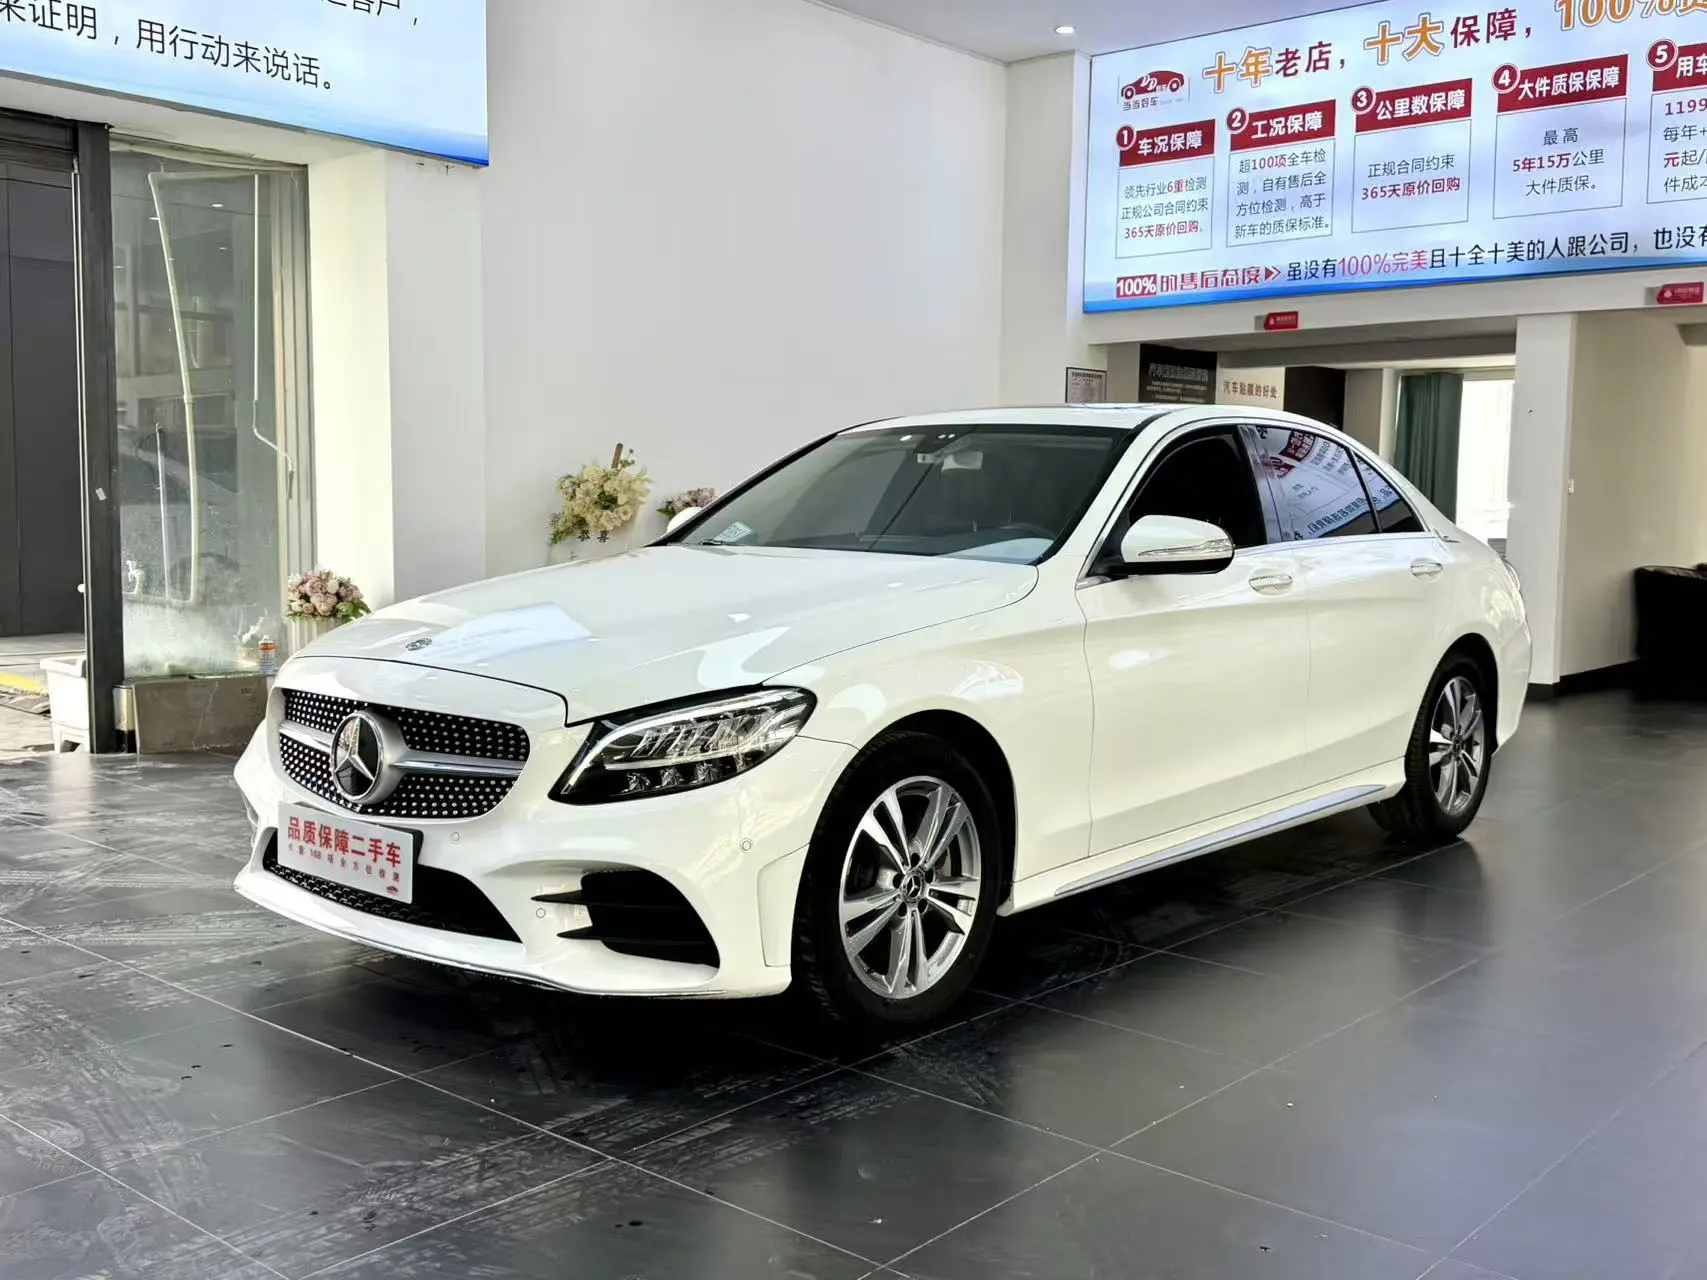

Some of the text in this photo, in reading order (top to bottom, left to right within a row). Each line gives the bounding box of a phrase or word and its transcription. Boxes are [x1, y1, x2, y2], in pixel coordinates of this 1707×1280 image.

[0, 0, 332, 90] 来证明，用行动来说话。
[1518, 66, 1620, 101] 大件质保保障
[1376, 89, 1466, 120] 公里数保障
[1252, 111, 1323, 139] 工况保障
[1543, 127, 1579, 146] 最高
[1137, 130, 1203, 156] 车况保障
[1239, 149, 1326, 174] 超100项全车检
[1368, 154, 1455, 178] 正规合同约束
[1512, 149, 1605, 172] 5年15万公里
[1664, 149, 1707, 168] 元起/
[1124, 176, 1208, 199] 领先行业6重检测
[1237, 171, 1327, 195] 测，自有售后全
[1361, 176, 1461, 200] 365天原价回购
[1526, 175, 1598, 196] 大件质保。
[1121, 198, 1209, 220] 正规公司合同约束
[1235, 193, 1326, 217] 方位检测，高于
[1234, 216, 1330, 239] 新车的质保标准。
[1223, 380, 1277, 399] 汽车贴膜的好处
[287, 816, 401, 868] 品质保障二手车
